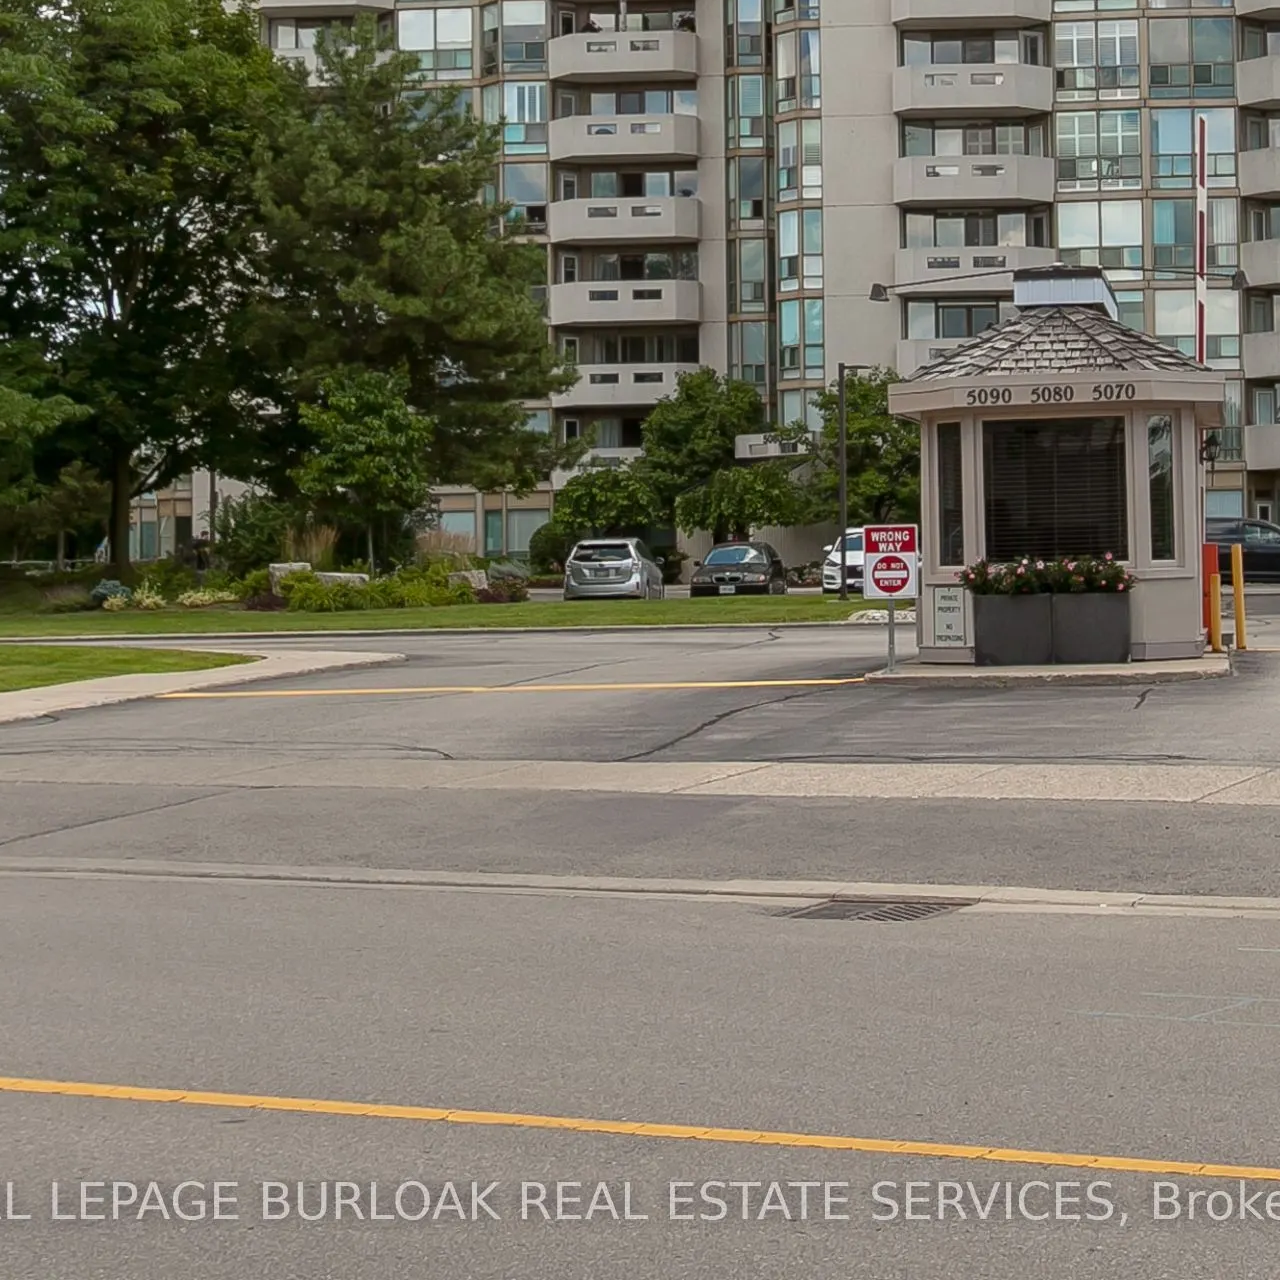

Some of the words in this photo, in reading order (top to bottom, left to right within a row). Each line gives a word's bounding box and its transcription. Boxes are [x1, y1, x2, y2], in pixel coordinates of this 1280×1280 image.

[966, 388, 1012, 405] 5090
[1030, 385, 1074, 404] 5080
[1092, 383, 1136, 401] 5070
[871, 531, 910, 541] WRONG
[878, 542, 902, 552] WAY
